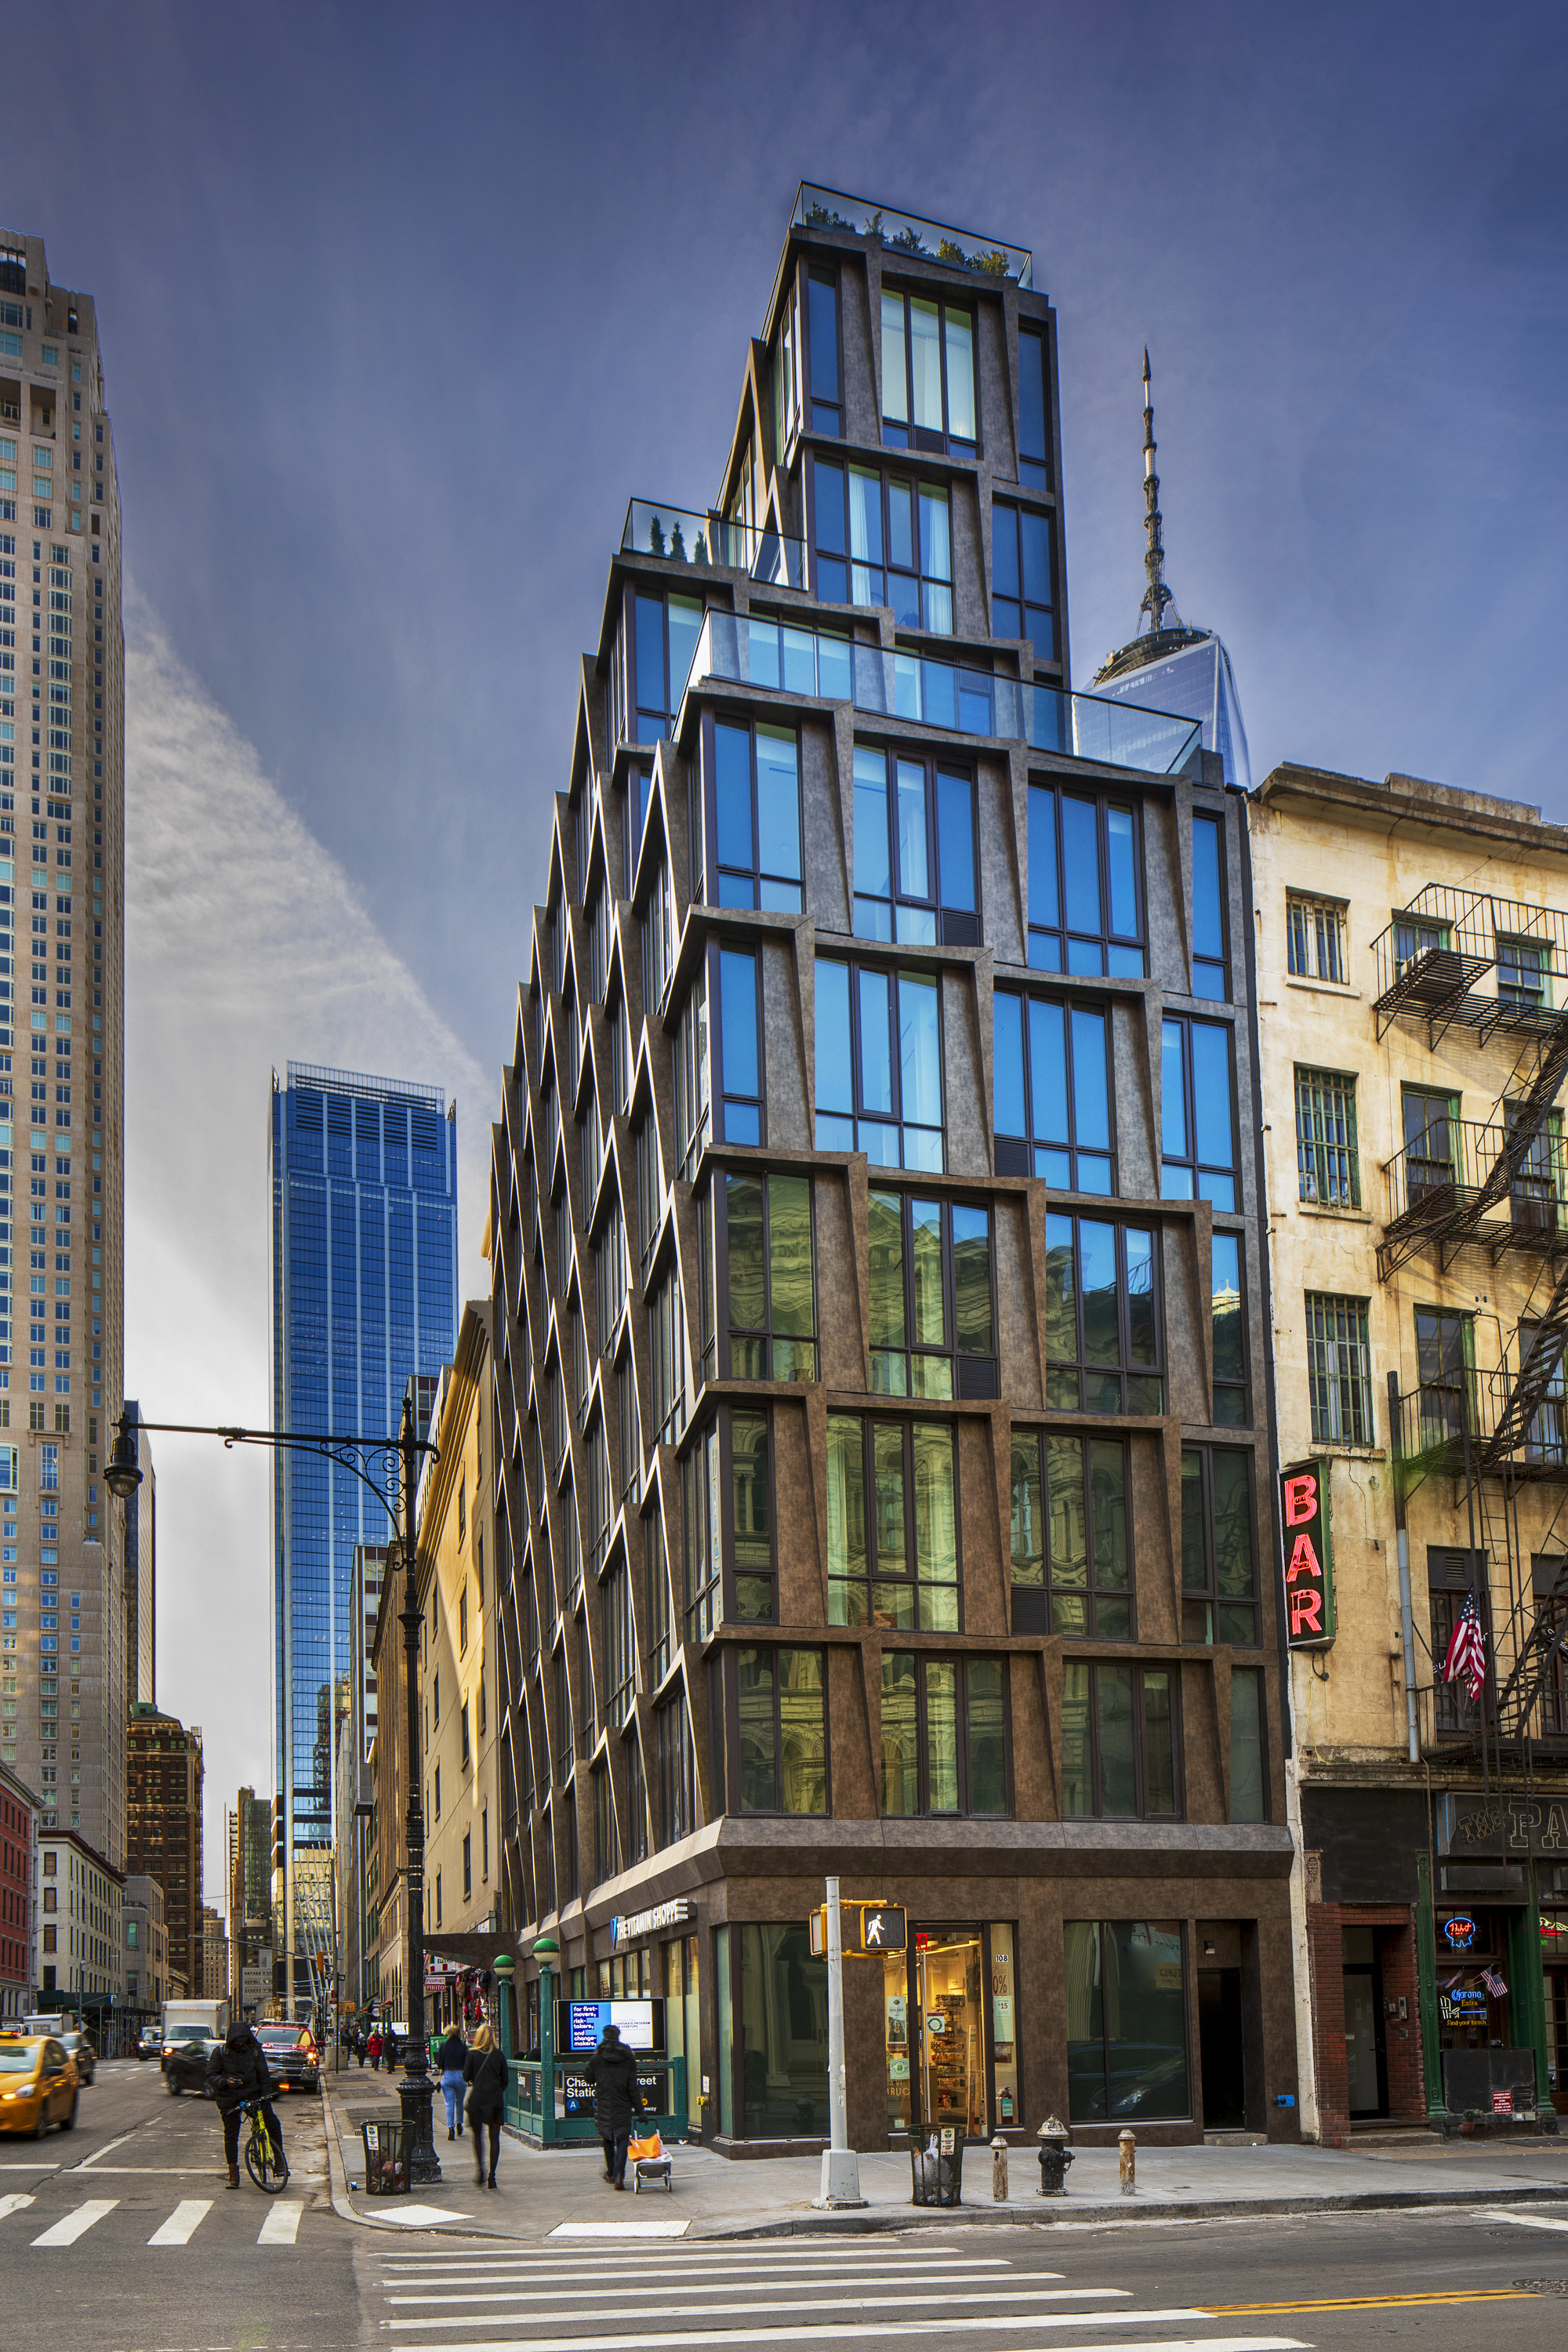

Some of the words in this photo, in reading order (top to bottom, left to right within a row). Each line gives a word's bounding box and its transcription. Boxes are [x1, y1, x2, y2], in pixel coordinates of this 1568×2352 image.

[1285, 1475, 1323, 1635] BAR
[1458, 1804, 1505, 1844] THE
[617, 1919, 628, 1941] THE
[627, 1909, 652, 1937] VITAMIN
[652, 1898, 688, 1929] SHOPPE
[1451, 1989, 1482, 2001] Corona
[636, 2076, 657, 2085] reet
